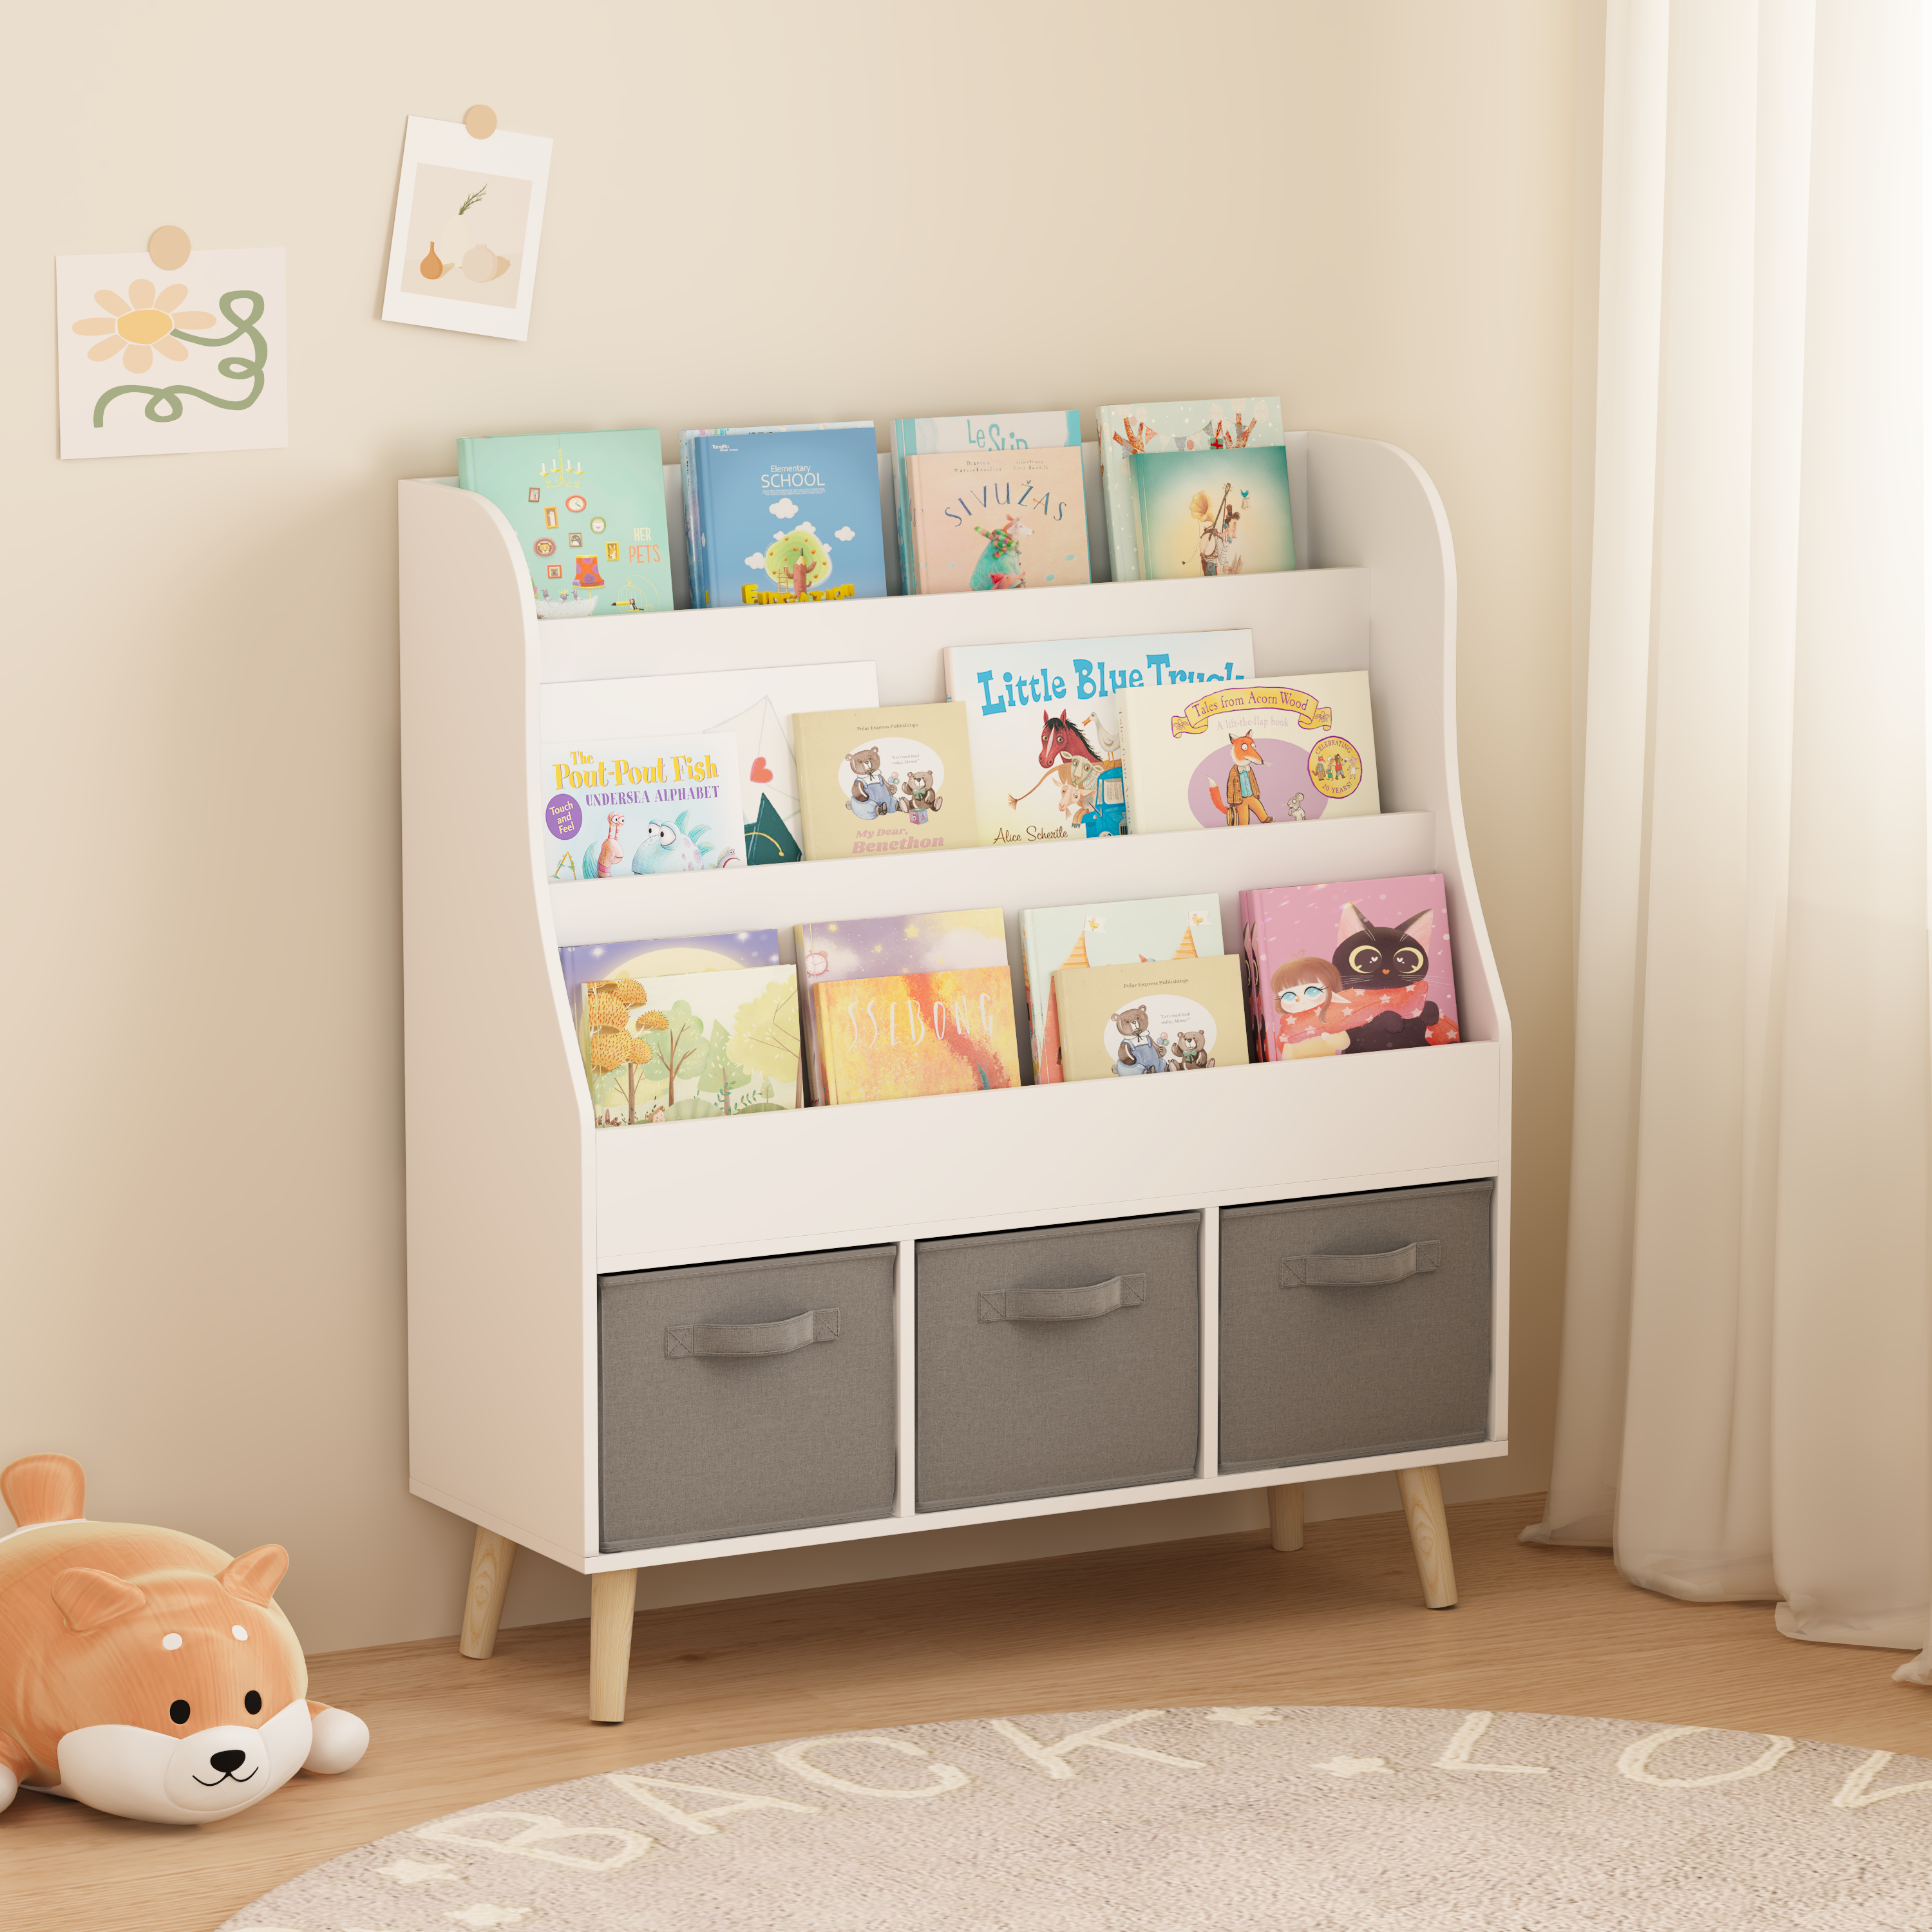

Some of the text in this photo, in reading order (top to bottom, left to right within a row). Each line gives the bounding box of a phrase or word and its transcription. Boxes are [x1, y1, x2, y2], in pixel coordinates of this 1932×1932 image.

[967, 419, 985, 448] Le
[761, 473, 825, 488] SCHOOL
[945, 480, 1066, 527] SIVUŽAS
[634, 527, 651, 542] HER
[629, 544, 661, 564] PETS
[977, 668, 1066, 716] Little
[1073, 659, 1144, 700] Blue
[1191, 691, 1309, 717] Tales from Acorn Wood
[1217, 716, 1289, 731] A lift-the-flap book
[1315, 739, 1352, 755] CELEBRATING
[570, 750, 594, 765] The
[551, 755, 719, 790] Pout-Pout Fish
[585, 785, 719, 806] UNDERSEA ALPHABET
[1322, 781, 1352, 793] 20 YEARS!
[549, 800, 574, 815] Touch
[557, 811, 572, 824] and
[558, 821, 575, 835] Feel
[856, 828, 908, 839] My Dear,
[993, 825, 1068, 844] Alice Schertle
[851, 836, 944, 854] Benethon
[848, 992, 993, 1054] SSEBONG
[411, 1709, 1208, 1870] BACK
